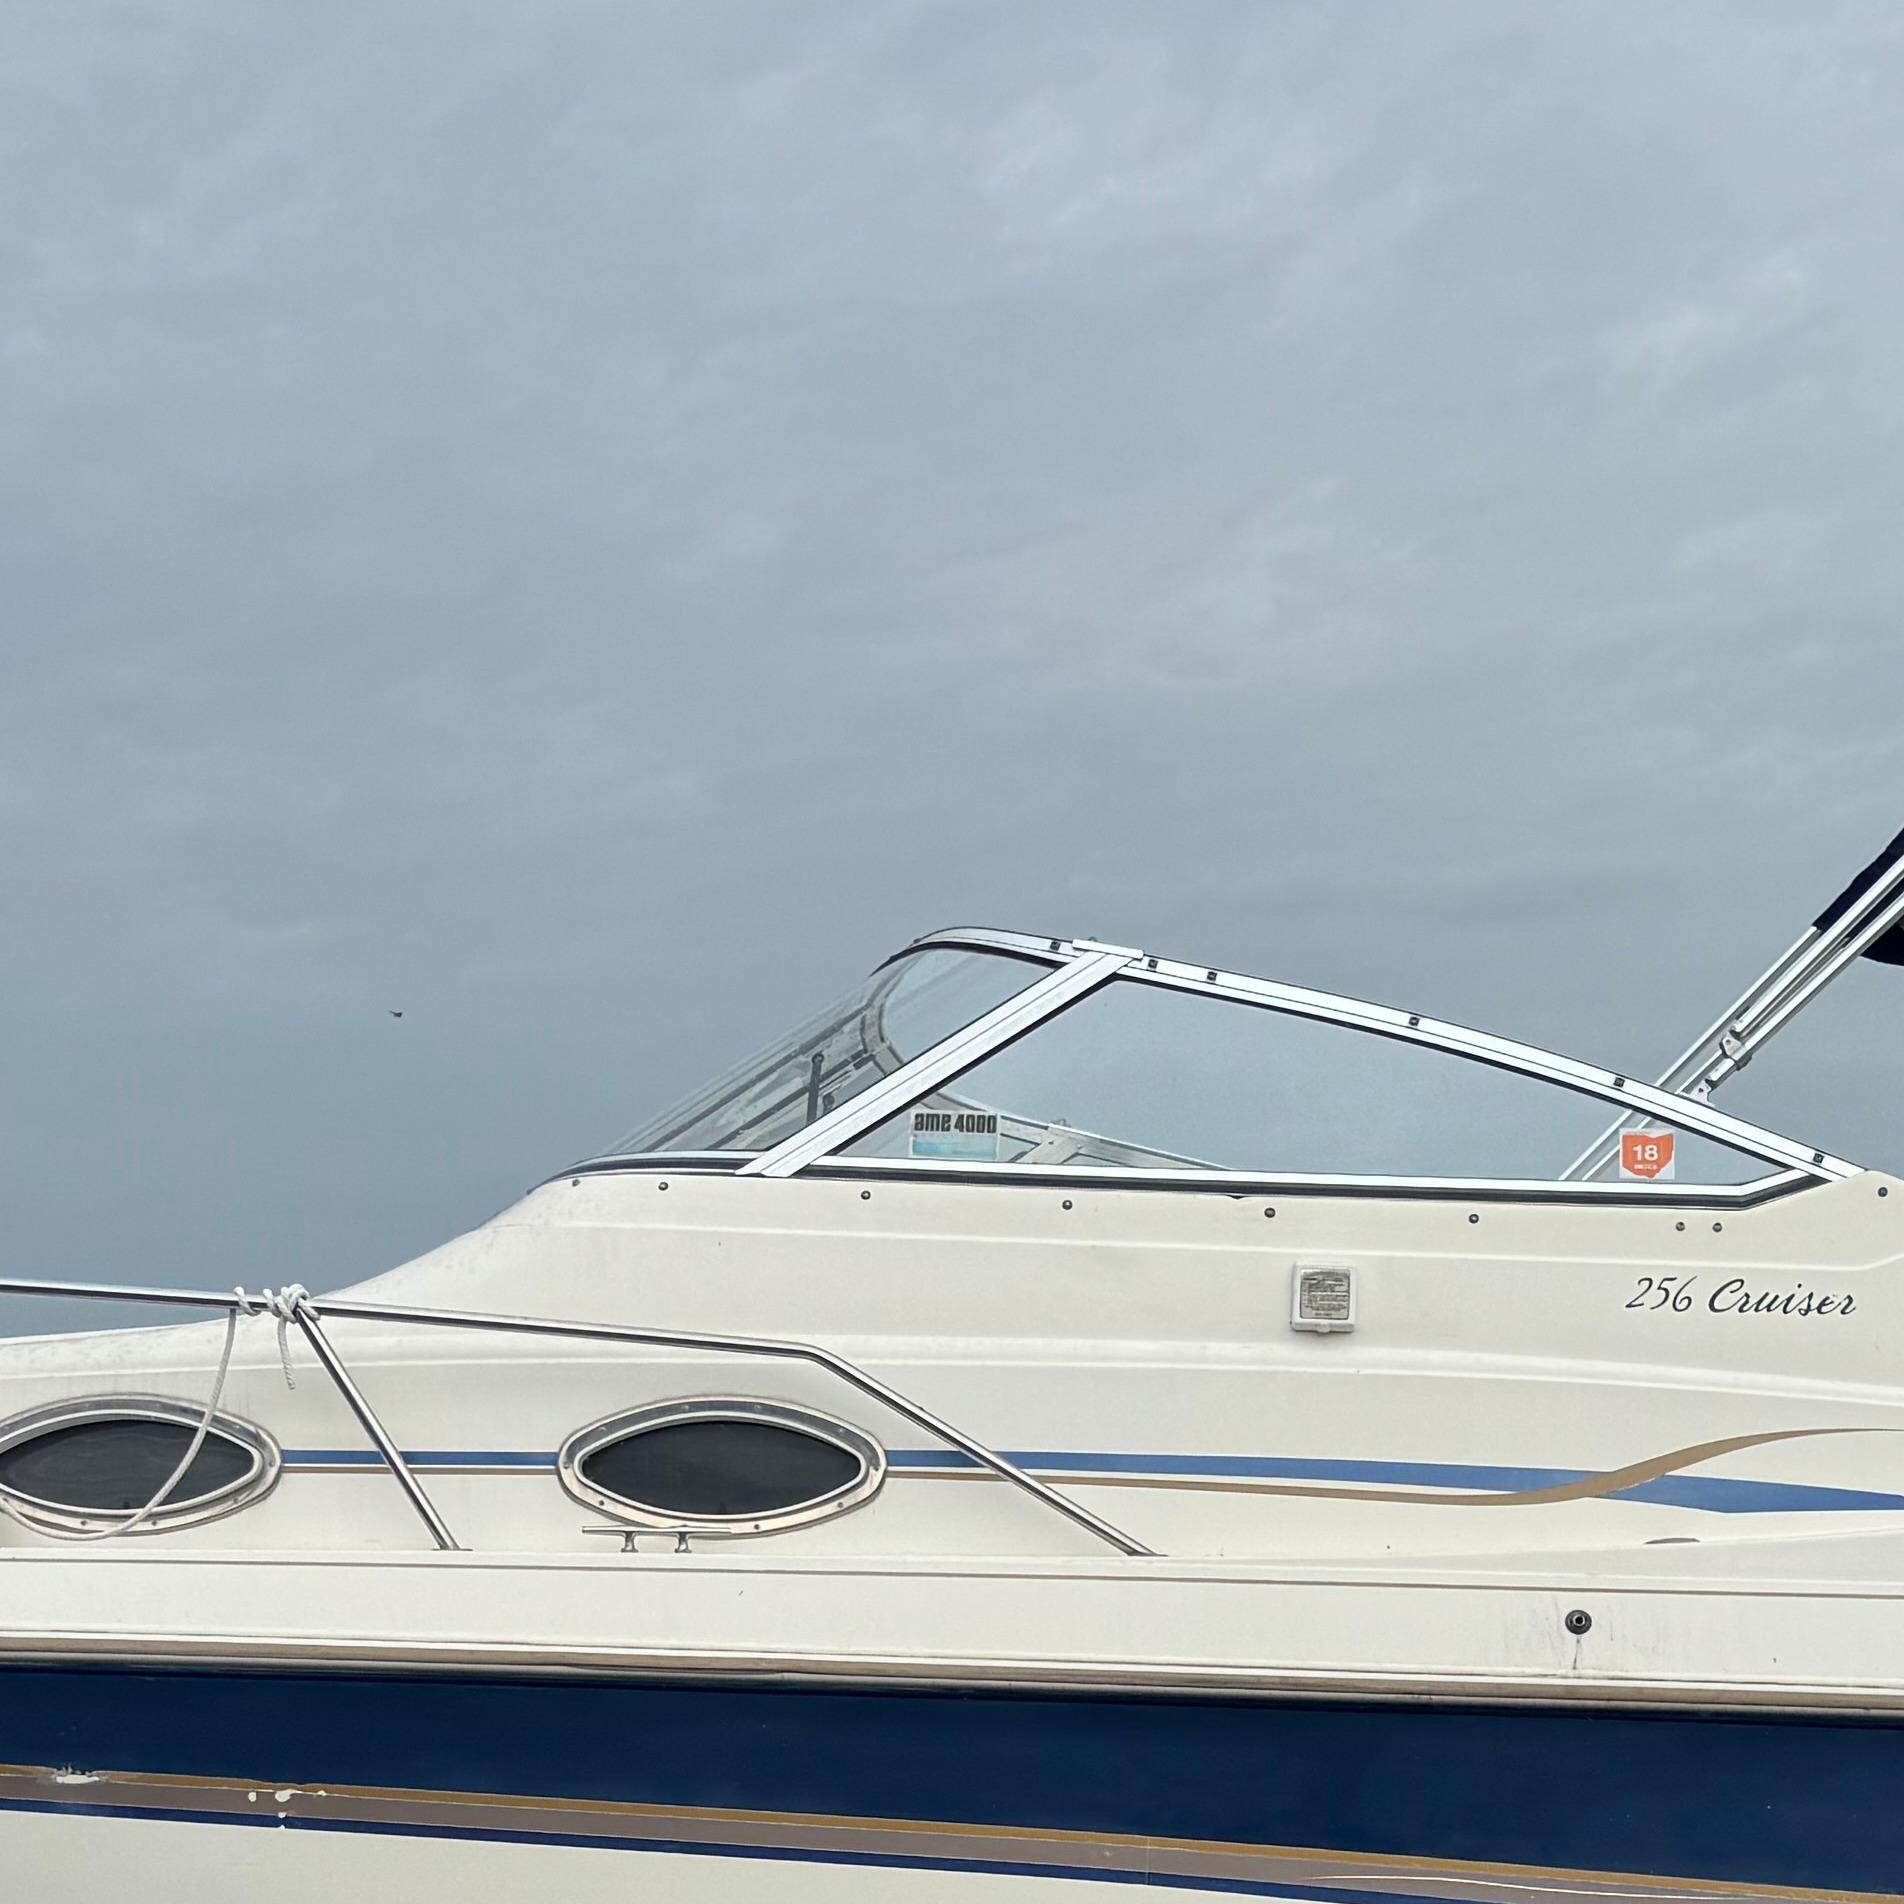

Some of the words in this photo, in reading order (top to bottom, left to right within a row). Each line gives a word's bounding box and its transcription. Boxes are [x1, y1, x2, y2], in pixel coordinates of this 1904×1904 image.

[954, 1114, 997, 1133] 4000
[1632, 1144, 1659, 1161] 18
[1625, 1275, 1698, 1313] 256
[1708, 1278, 1857, 1317] Cruiser
